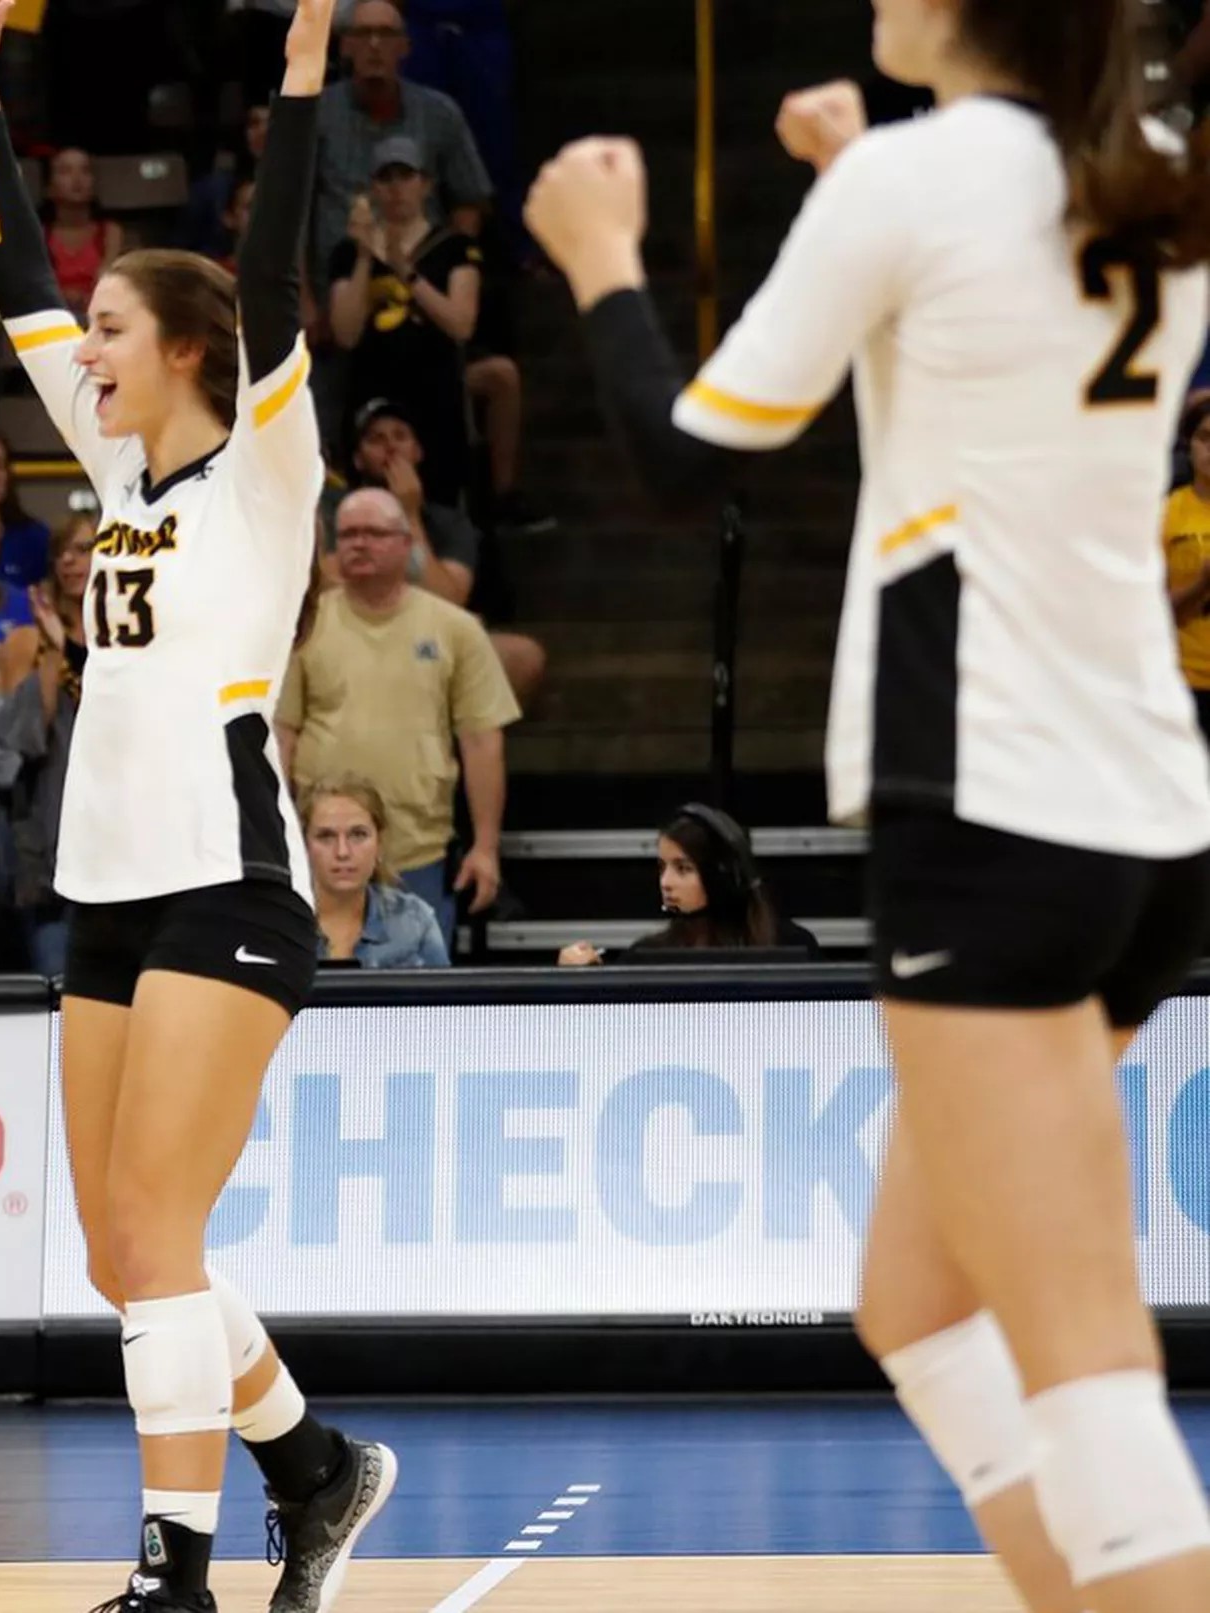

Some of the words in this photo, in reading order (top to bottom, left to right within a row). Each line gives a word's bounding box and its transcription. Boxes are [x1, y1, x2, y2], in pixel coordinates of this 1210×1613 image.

[1079, 238, 1161, 406] 2
[93, 567, 156, 649] 13
[690, 1311, 823, 1326] DAKTRONICS
